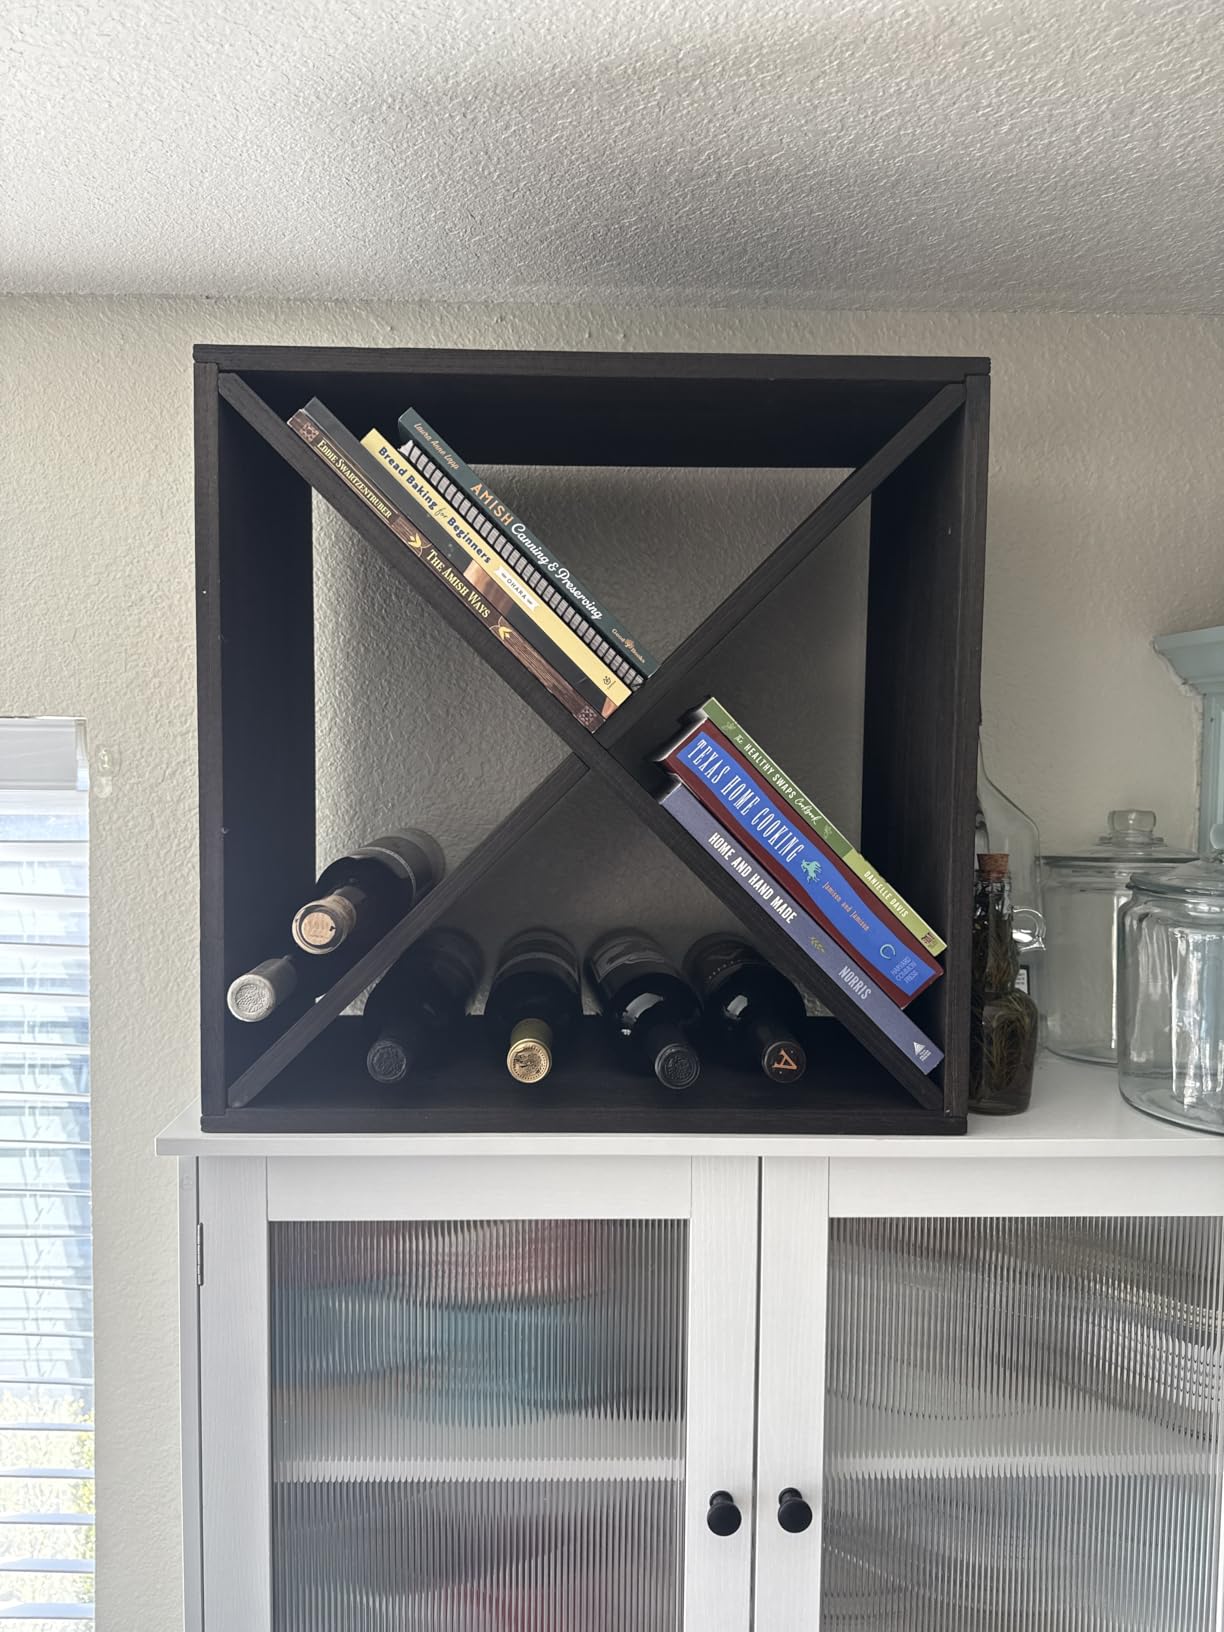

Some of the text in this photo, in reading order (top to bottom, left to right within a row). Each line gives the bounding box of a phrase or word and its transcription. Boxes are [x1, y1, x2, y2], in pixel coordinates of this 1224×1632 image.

[317, 440, 392, 519] EDDIE SWARTZENTRUBER
[414, 423, 460, 470] Laura Anne Lapp
[378, 446, 492, 564] Bread Baking for Beginners
[427, 549, 491, 618] THE AMISH WAYS
[470, 483, 603, 619] AMISH Canning & Preserving
[687, 739, 805, 863] TEXAS HOME COOKING
[744, 743, 774, 775] HEALTHY
[772, 773, 796, 799] SWAPS
[795, 798, 822, 825] Cookbook
[708, 832, 798, 924] HOME AND HAND MADE
[863, 871, 909, 918] DANIELLE DAVIS
[838, 965, 872, 1000] NORRIS
